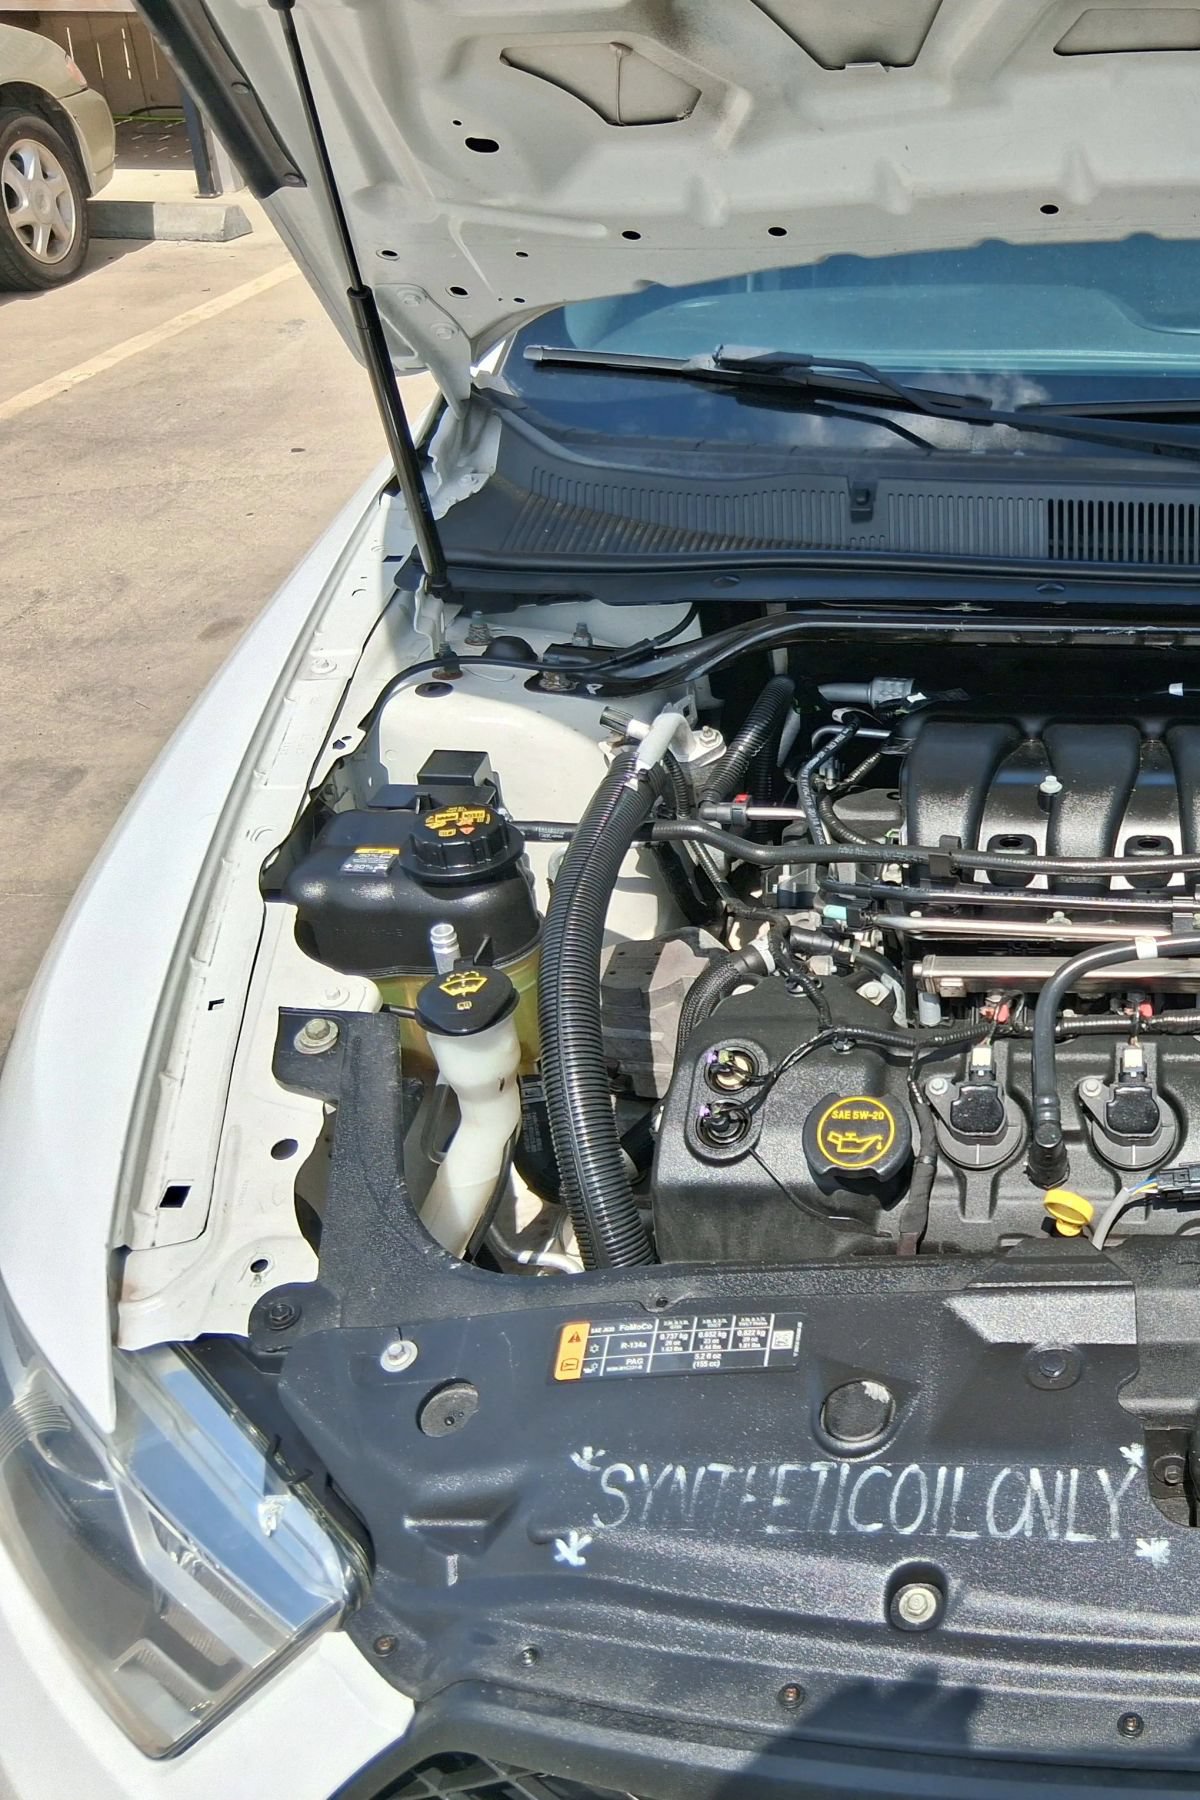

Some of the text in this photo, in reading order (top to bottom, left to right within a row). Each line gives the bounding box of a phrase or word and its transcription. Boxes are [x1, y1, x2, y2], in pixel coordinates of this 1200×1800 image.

[832, 1110, 884, 1120] SAE 5W-20
[619, 1323, 654, 1332] FoMoCo
[679, 1331, 689, 1341] kg
[717, 1330, 727, 1339] kg
[756, 1328, 766, 1338] kg
[620, 1341, 648, 1350] R-134a
[625, 1358, 644, 1366] PAG
[692, 1360, 721, 1369] (155 cc)
